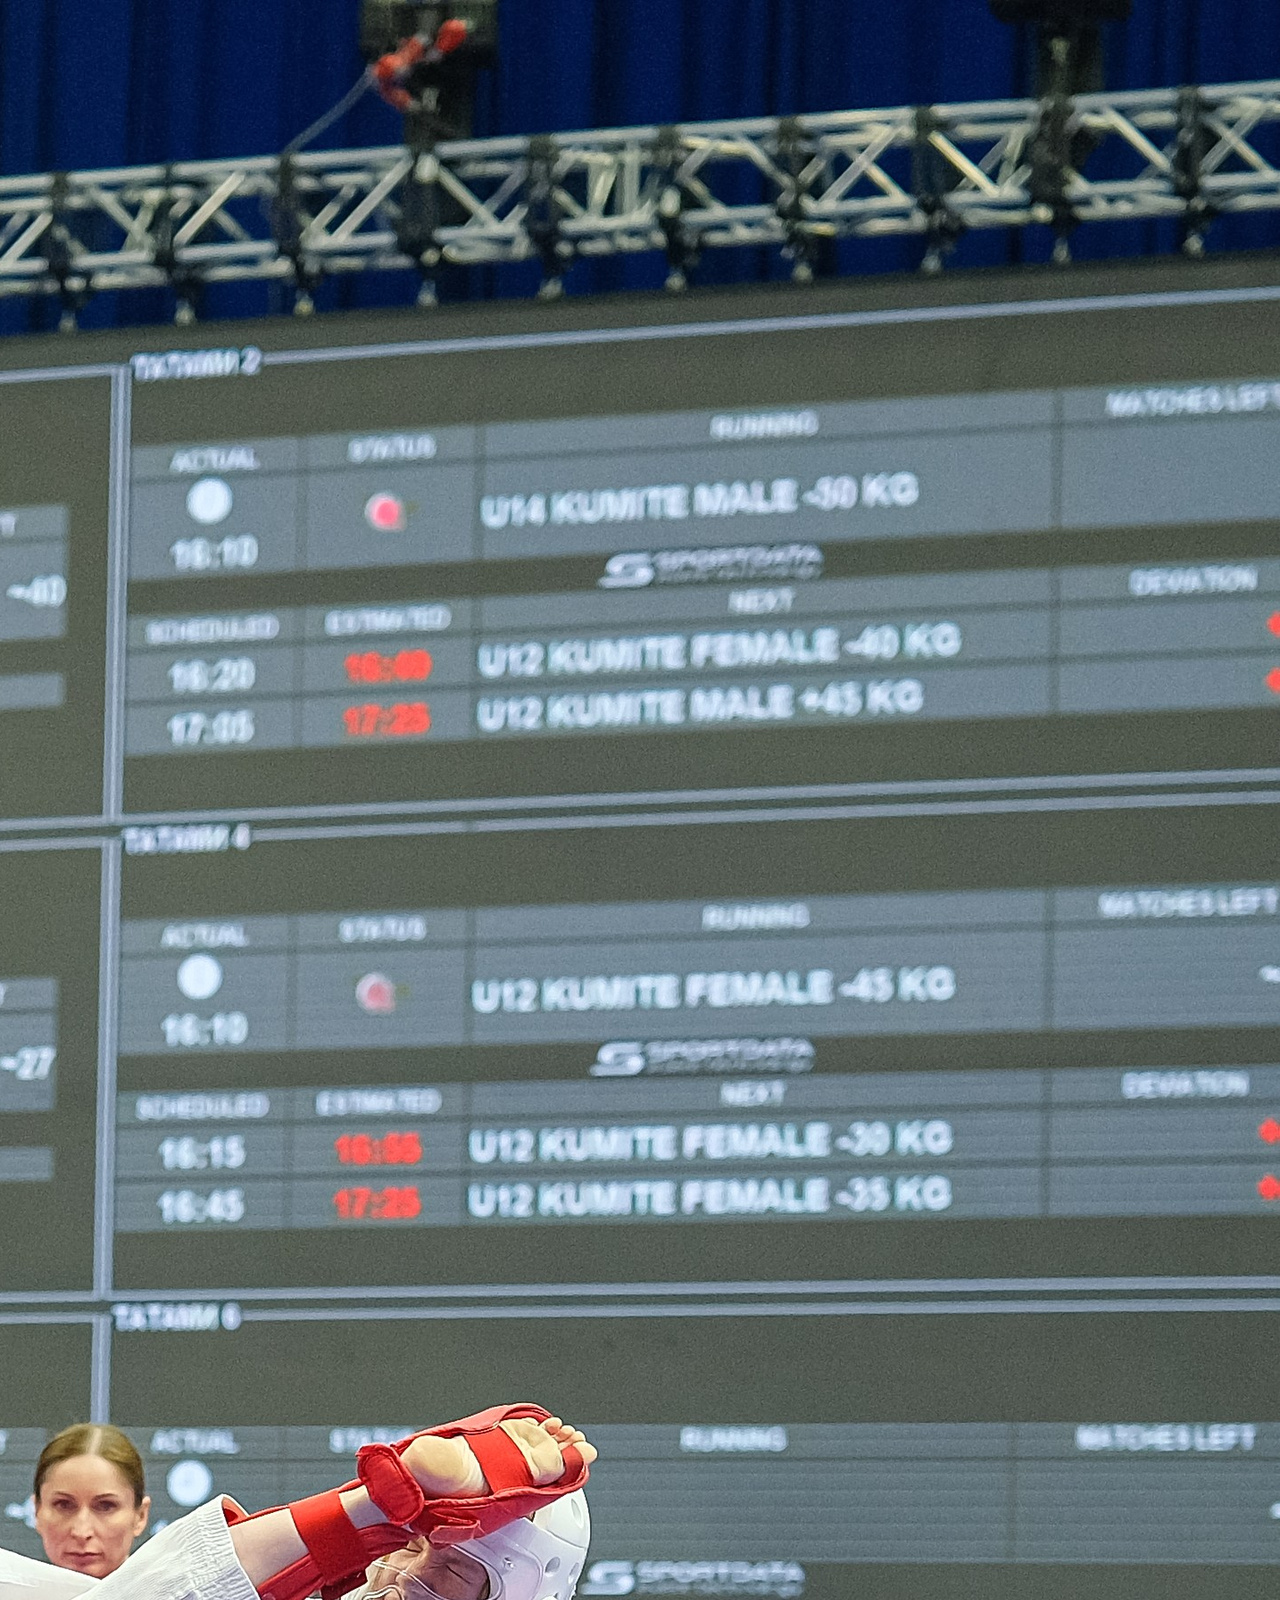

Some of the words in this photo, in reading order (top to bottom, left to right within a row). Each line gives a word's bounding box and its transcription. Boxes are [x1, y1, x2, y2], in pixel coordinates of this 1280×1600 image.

[549, 485, 688, 522] KUMITE
[693, 479, 797, 516] MALE
[477, 643, 544, 678] U12
[547, 635, 686, 674] KUMITE
[690, 627, 840, 667] FEMALE
[477, 697, 543, 732] U12
[546, 689, 686, 728] KUMITE
[690, 684, 794, 721] MALE
[471, 978, 538, 1012] U12
[541, 974, 681, 1010] KUMITE
[685, 968, 834, 1005] FEMALE
[468, 1128, 534, 1164] U12
[538, 1125, 677, 1161] KUMITE
[682, 1121, 831, 1159] FEMALE
[467, 1182, 533, 1217] U12
[537, 1179, 676, 1216] KUMITE
[680, 1177, 830, 1214] FEMALE
